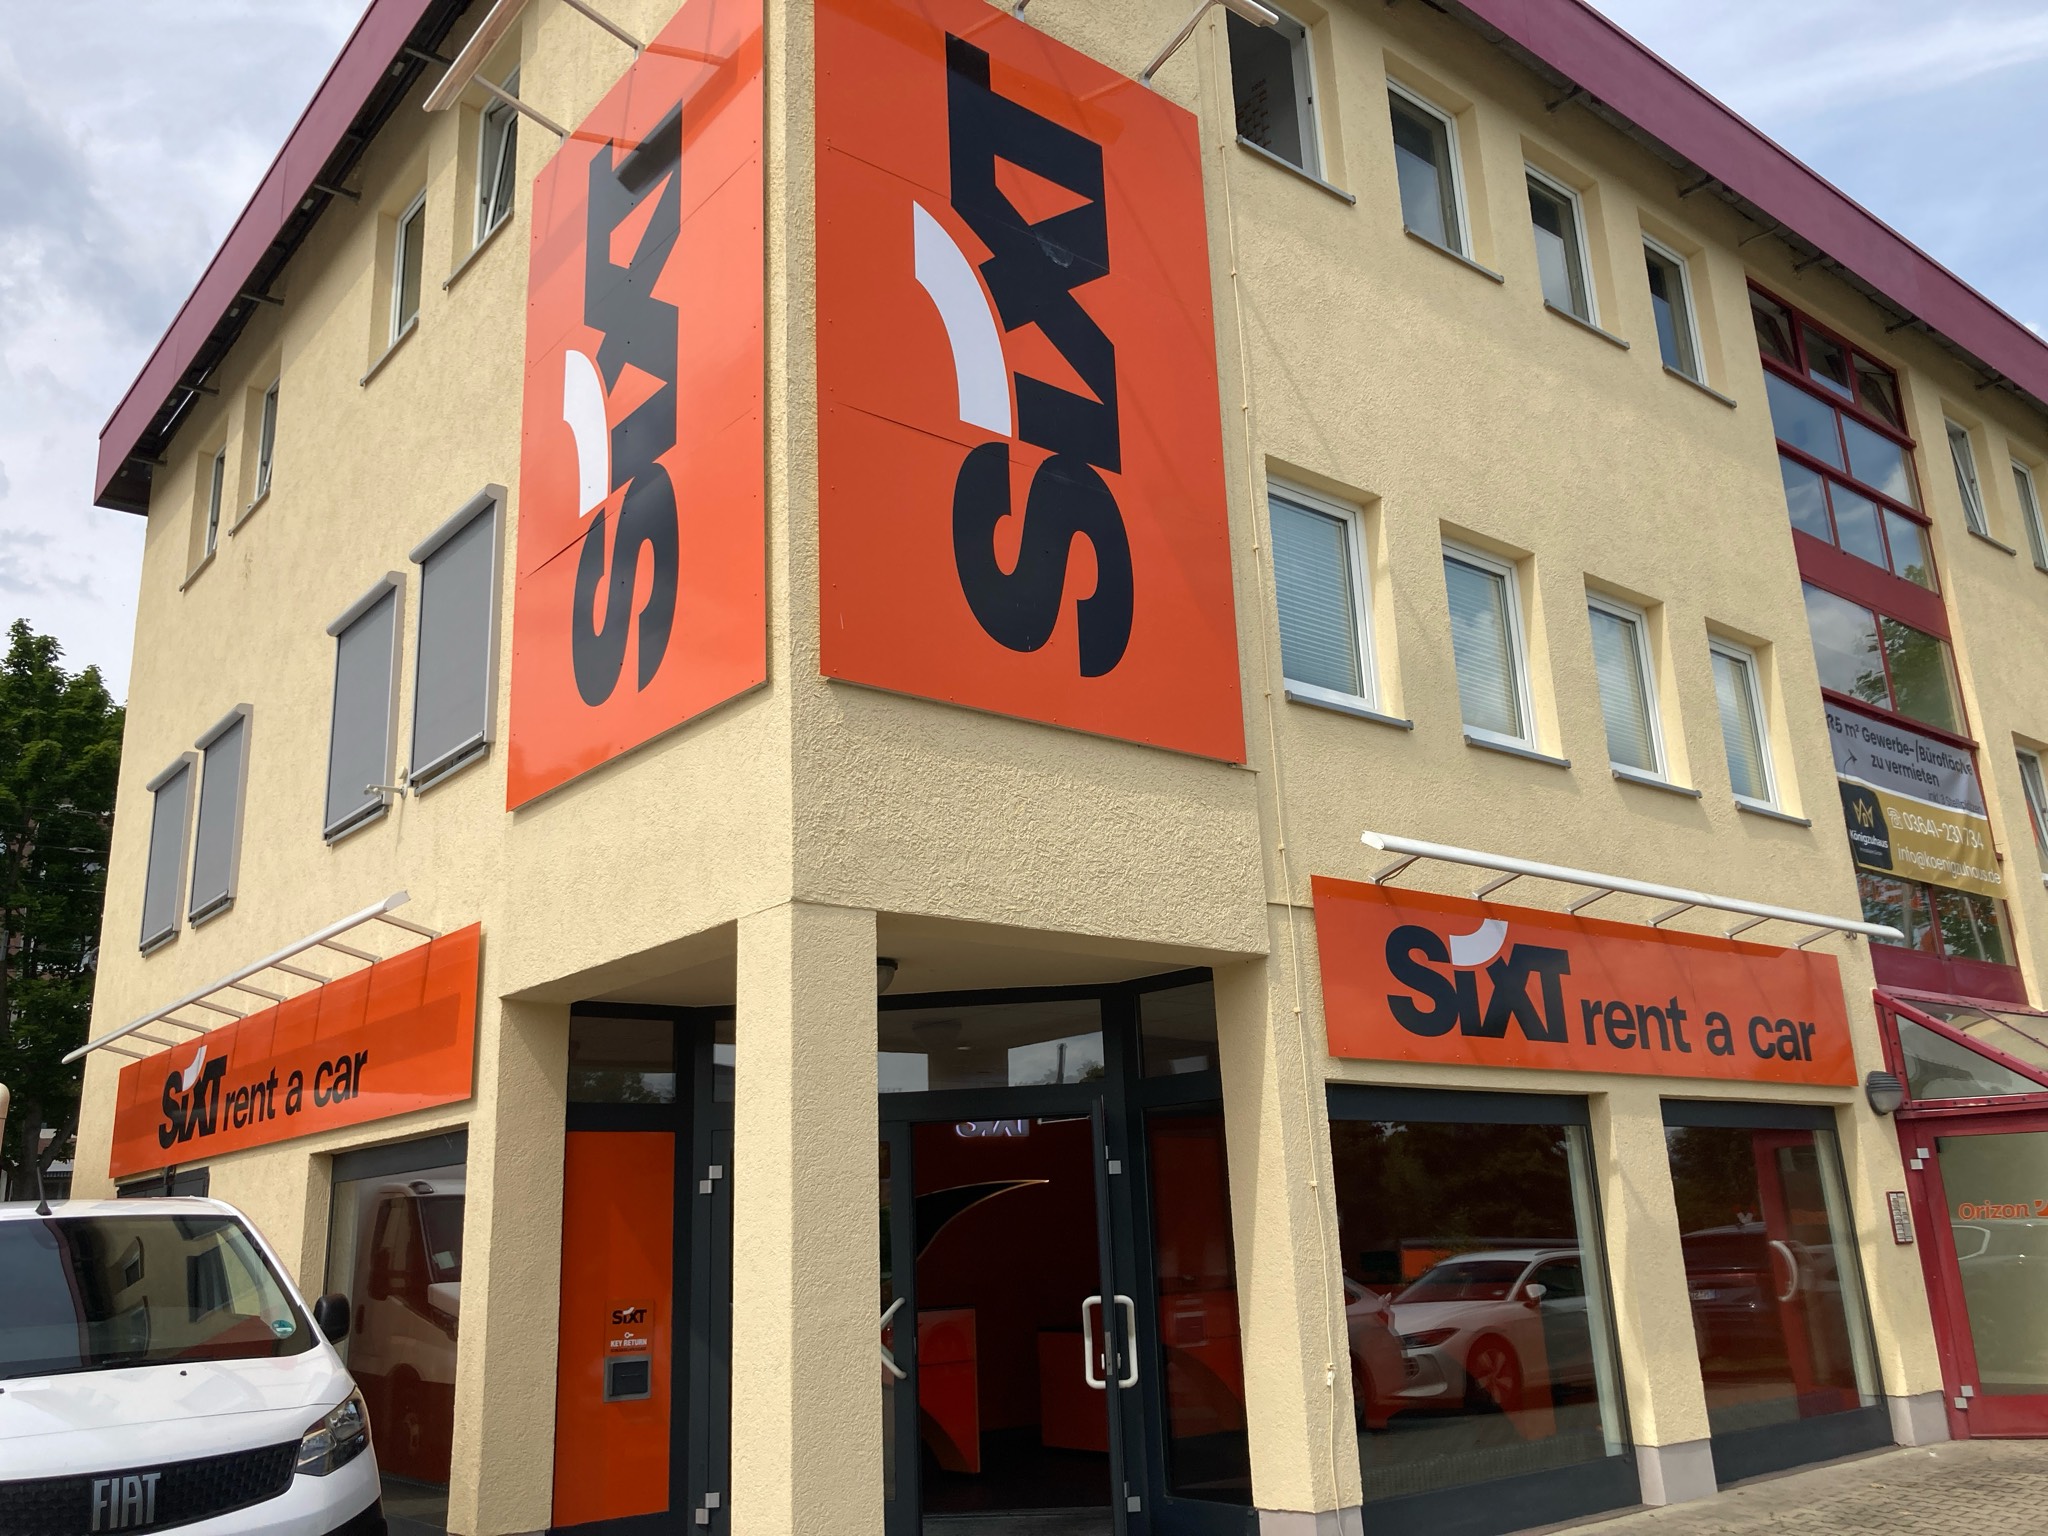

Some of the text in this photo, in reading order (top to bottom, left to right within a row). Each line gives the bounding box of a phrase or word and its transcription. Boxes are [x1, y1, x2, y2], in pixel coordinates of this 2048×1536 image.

[1871, 755, 1939, 787] zu vermieten
[1580, 996, 1691, 1054] rent
[1706, 1011, 1735, 1057] a
[1748, 1015, 1816, 1063] car
[223, 1065, 278, 1132] rent
[285, 1069, 304, 1116] a
[314, 1049, 368, 1108] car
[1958, 1200, 2030, 1220] Orizon
[610, 1338, 647, 1348] KEY RETURN
[92, 1473, 161, 1531] FIAT
